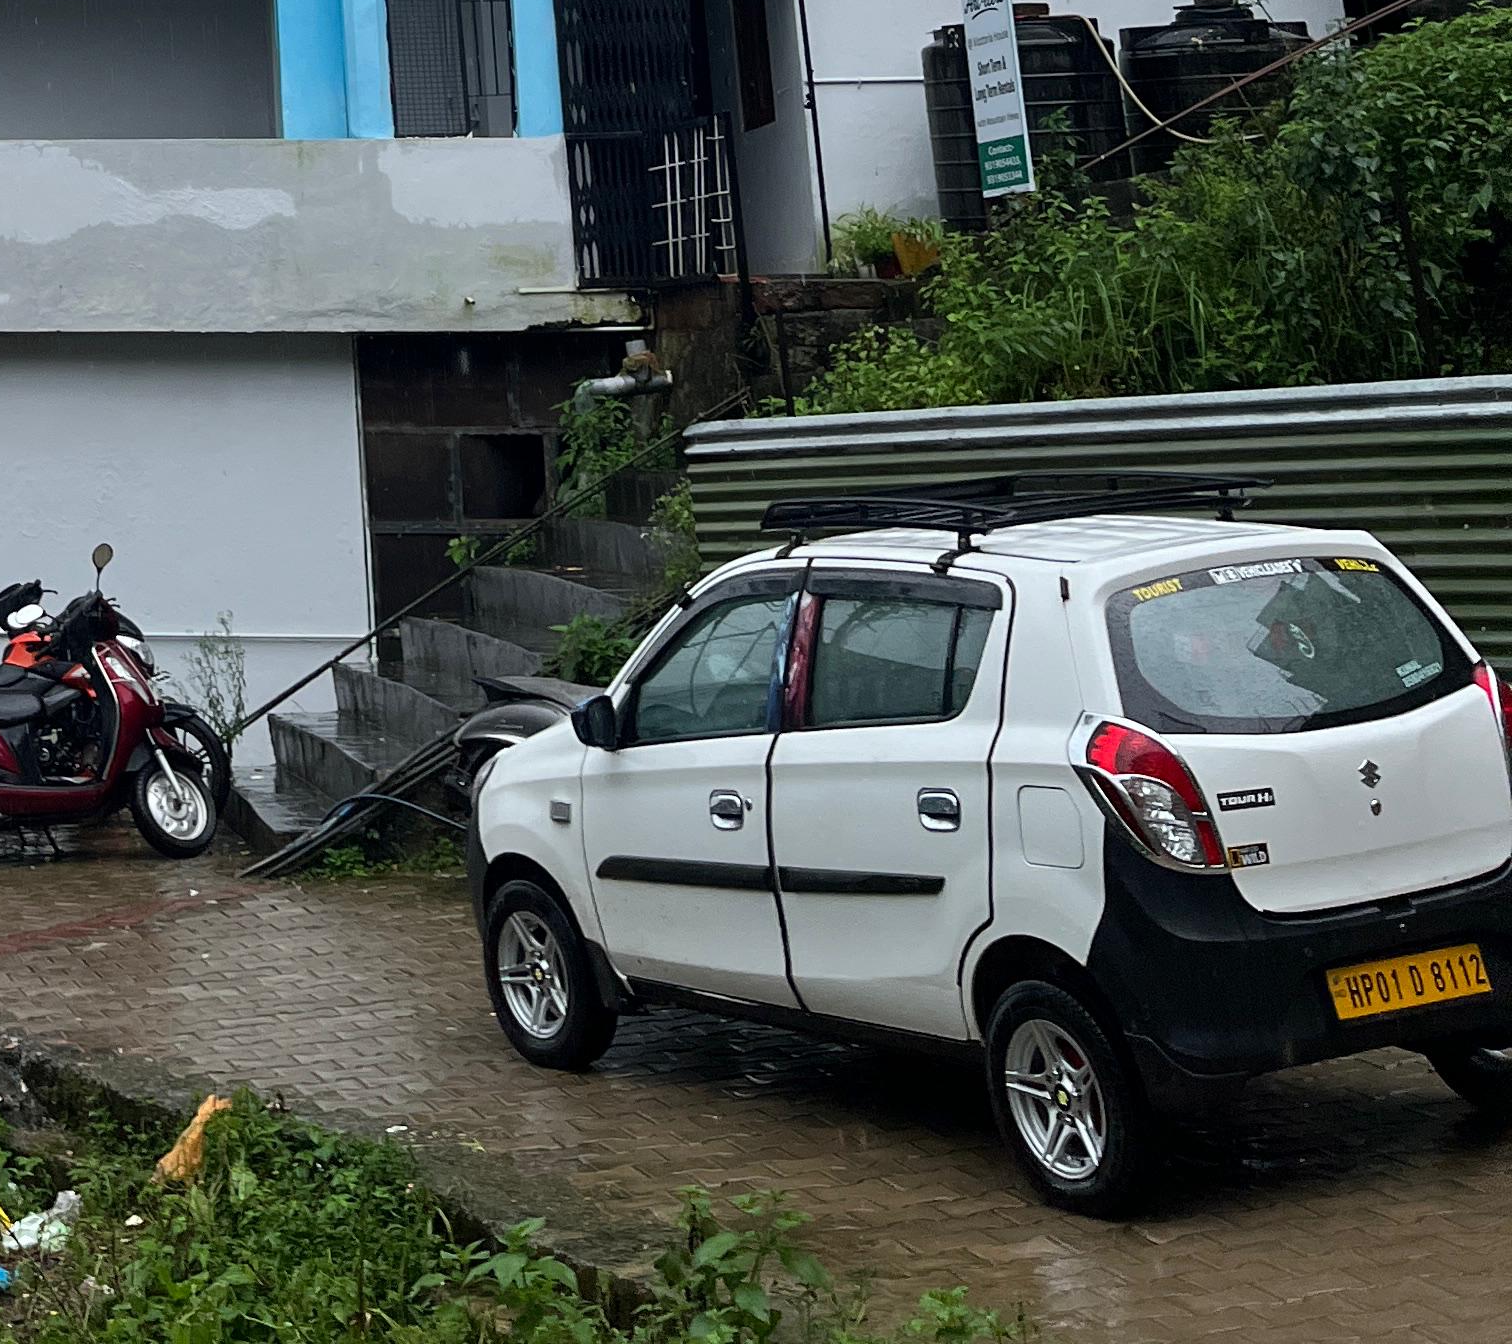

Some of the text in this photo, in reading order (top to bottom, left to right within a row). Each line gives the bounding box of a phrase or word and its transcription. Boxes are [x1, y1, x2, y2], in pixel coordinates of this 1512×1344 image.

[1132, 577, 1183, 602] TOURIST
[1219, 793, 1256, 806] TOUR
[1345, 968, 1404, 1009] HP01
[1408, 965, 1425, 996] D
[1430, 953, 1487, 993] 8112
